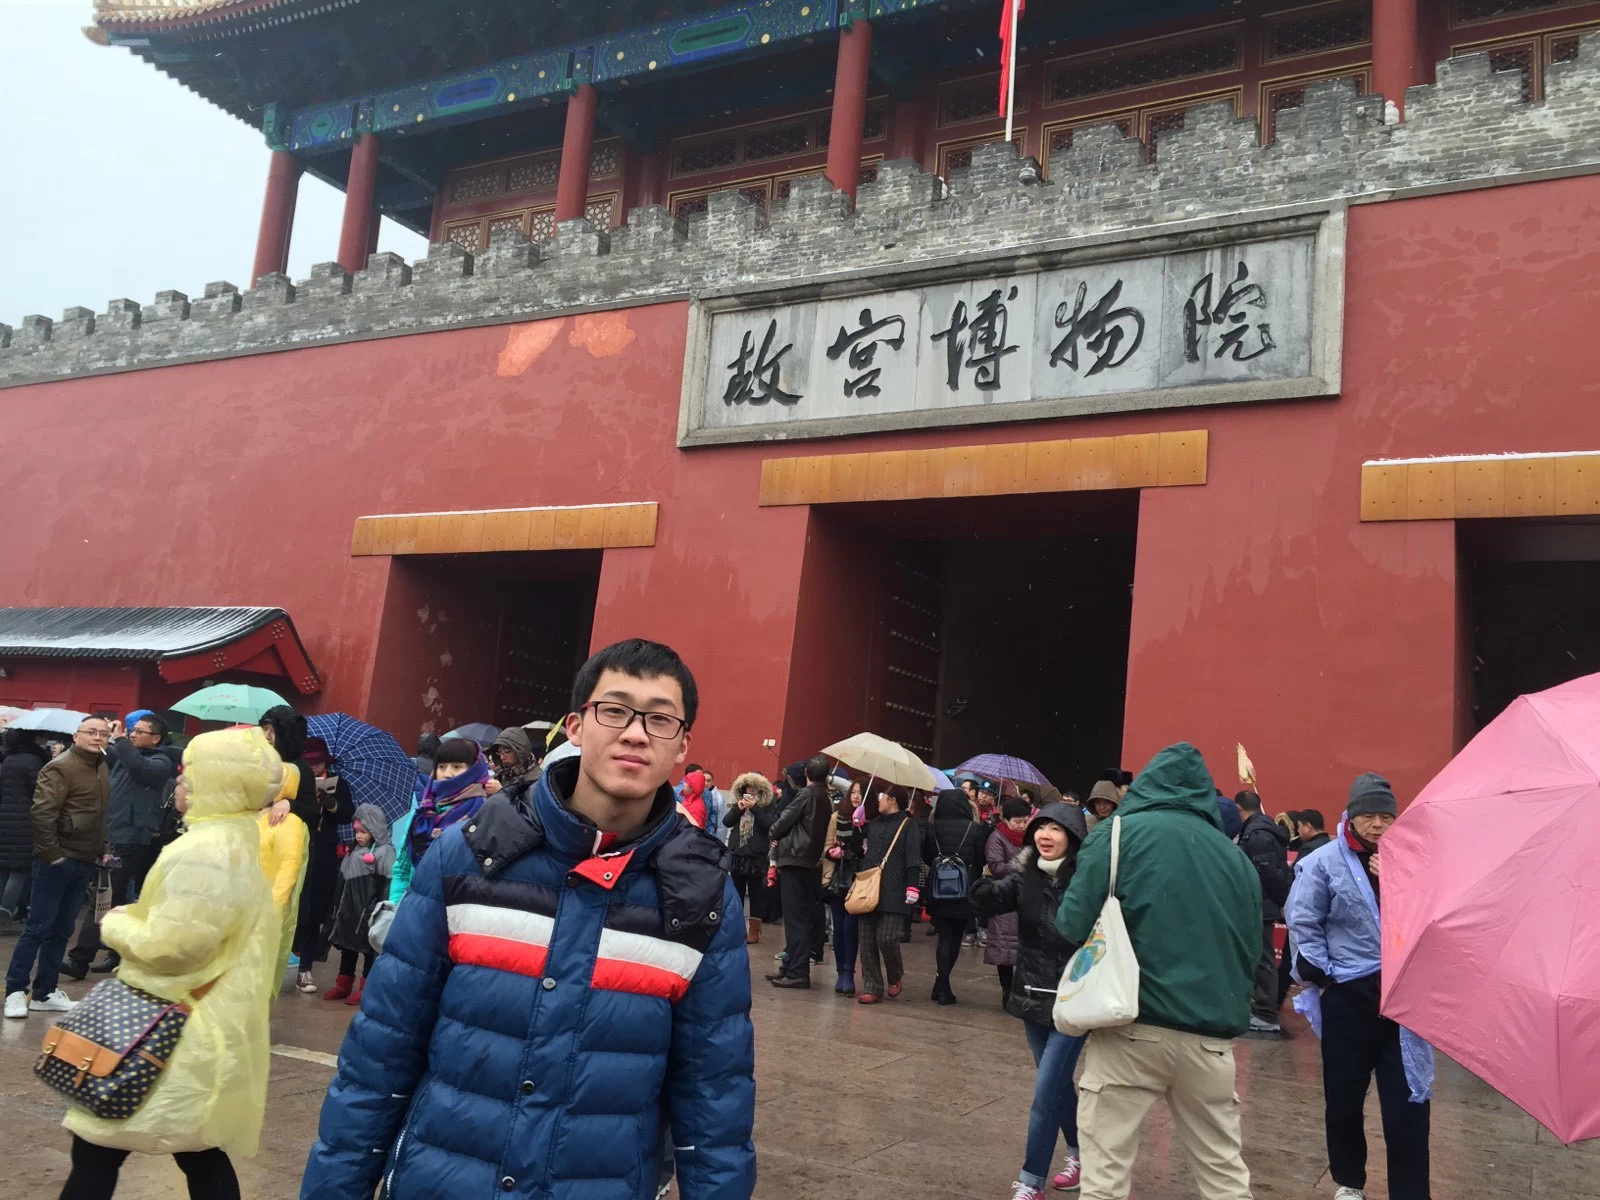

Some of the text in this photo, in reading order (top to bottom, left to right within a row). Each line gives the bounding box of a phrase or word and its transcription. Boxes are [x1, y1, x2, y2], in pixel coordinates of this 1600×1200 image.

[723, 261, 1277, 406] 故宫博物院
